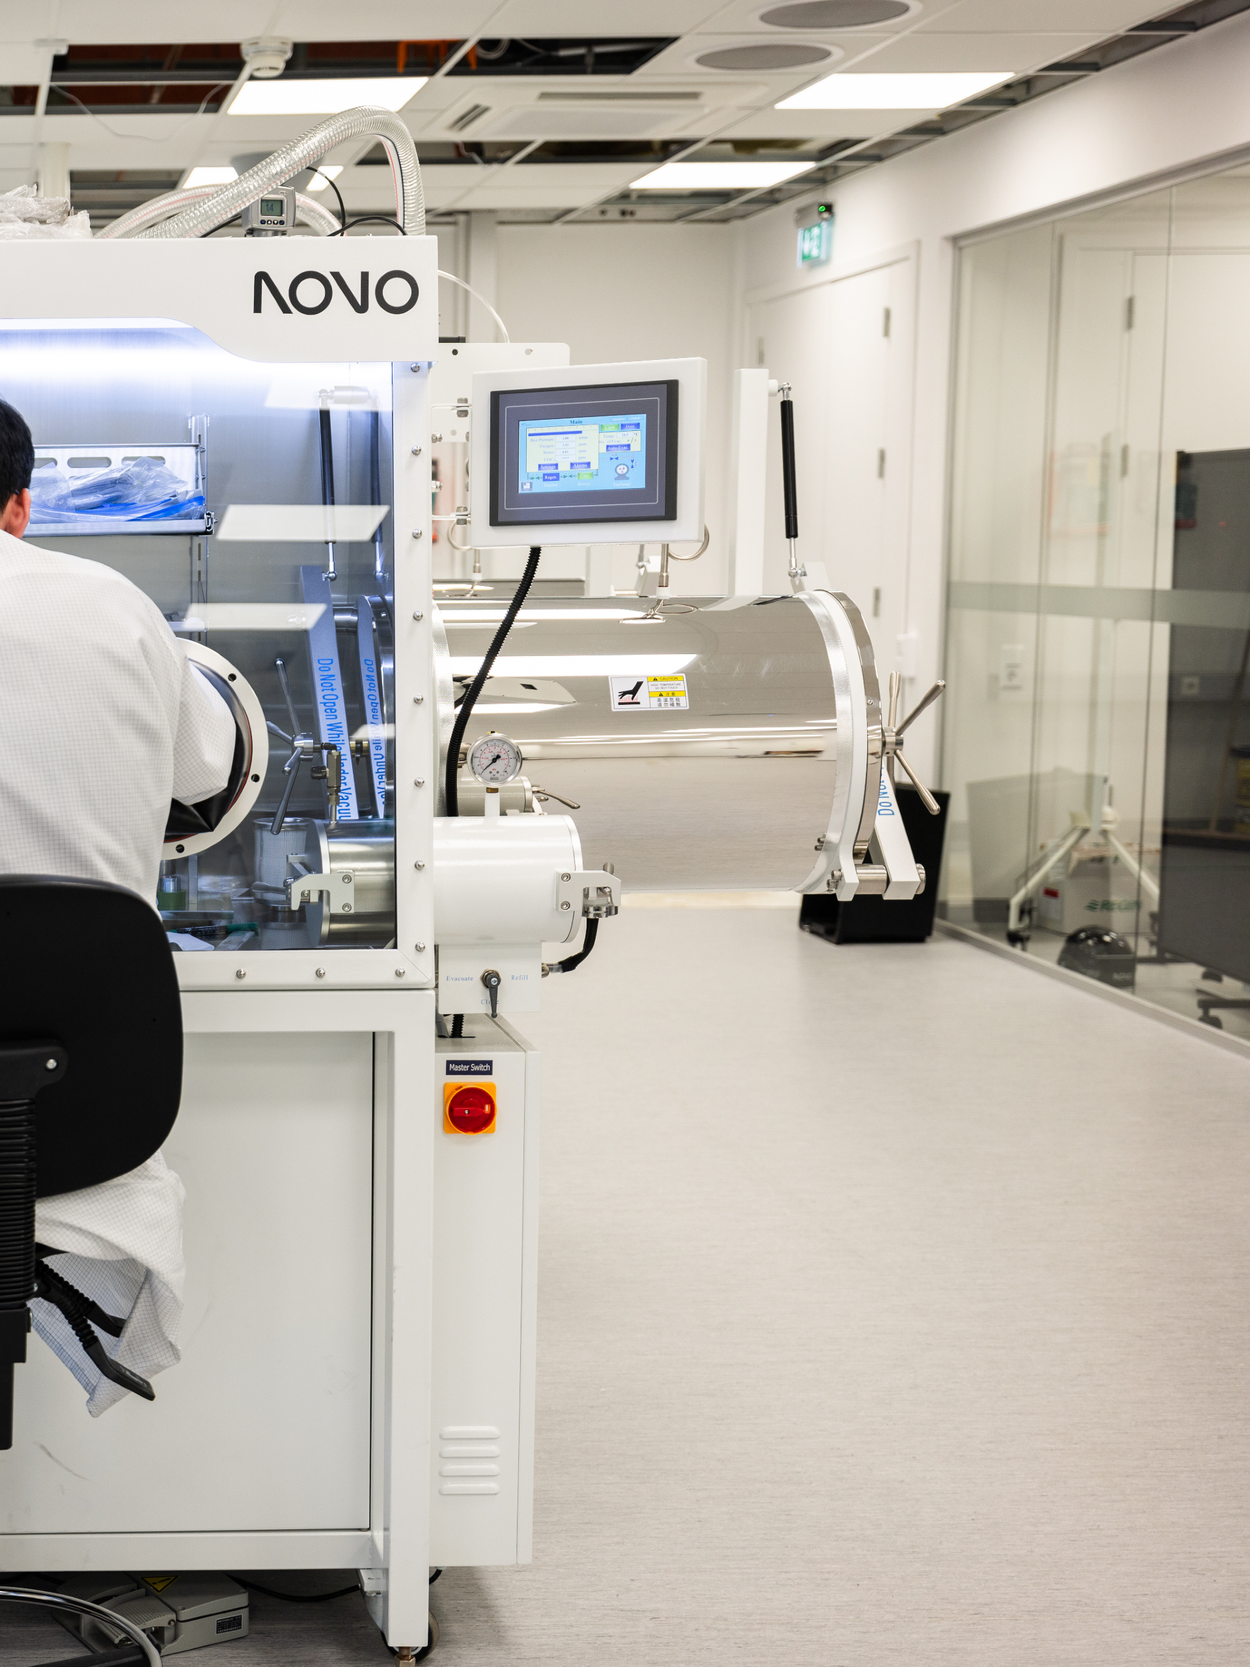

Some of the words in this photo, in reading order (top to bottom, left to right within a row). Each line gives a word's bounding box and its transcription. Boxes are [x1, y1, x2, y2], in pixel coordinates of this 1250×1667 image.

[253, 270, 420, 316] NOVO
[318, 658, 333, 672] Do
[320, 674, 336, 692] Not
[320, 694, 339, 720] Open
[878, 802, 895, 815] Do
